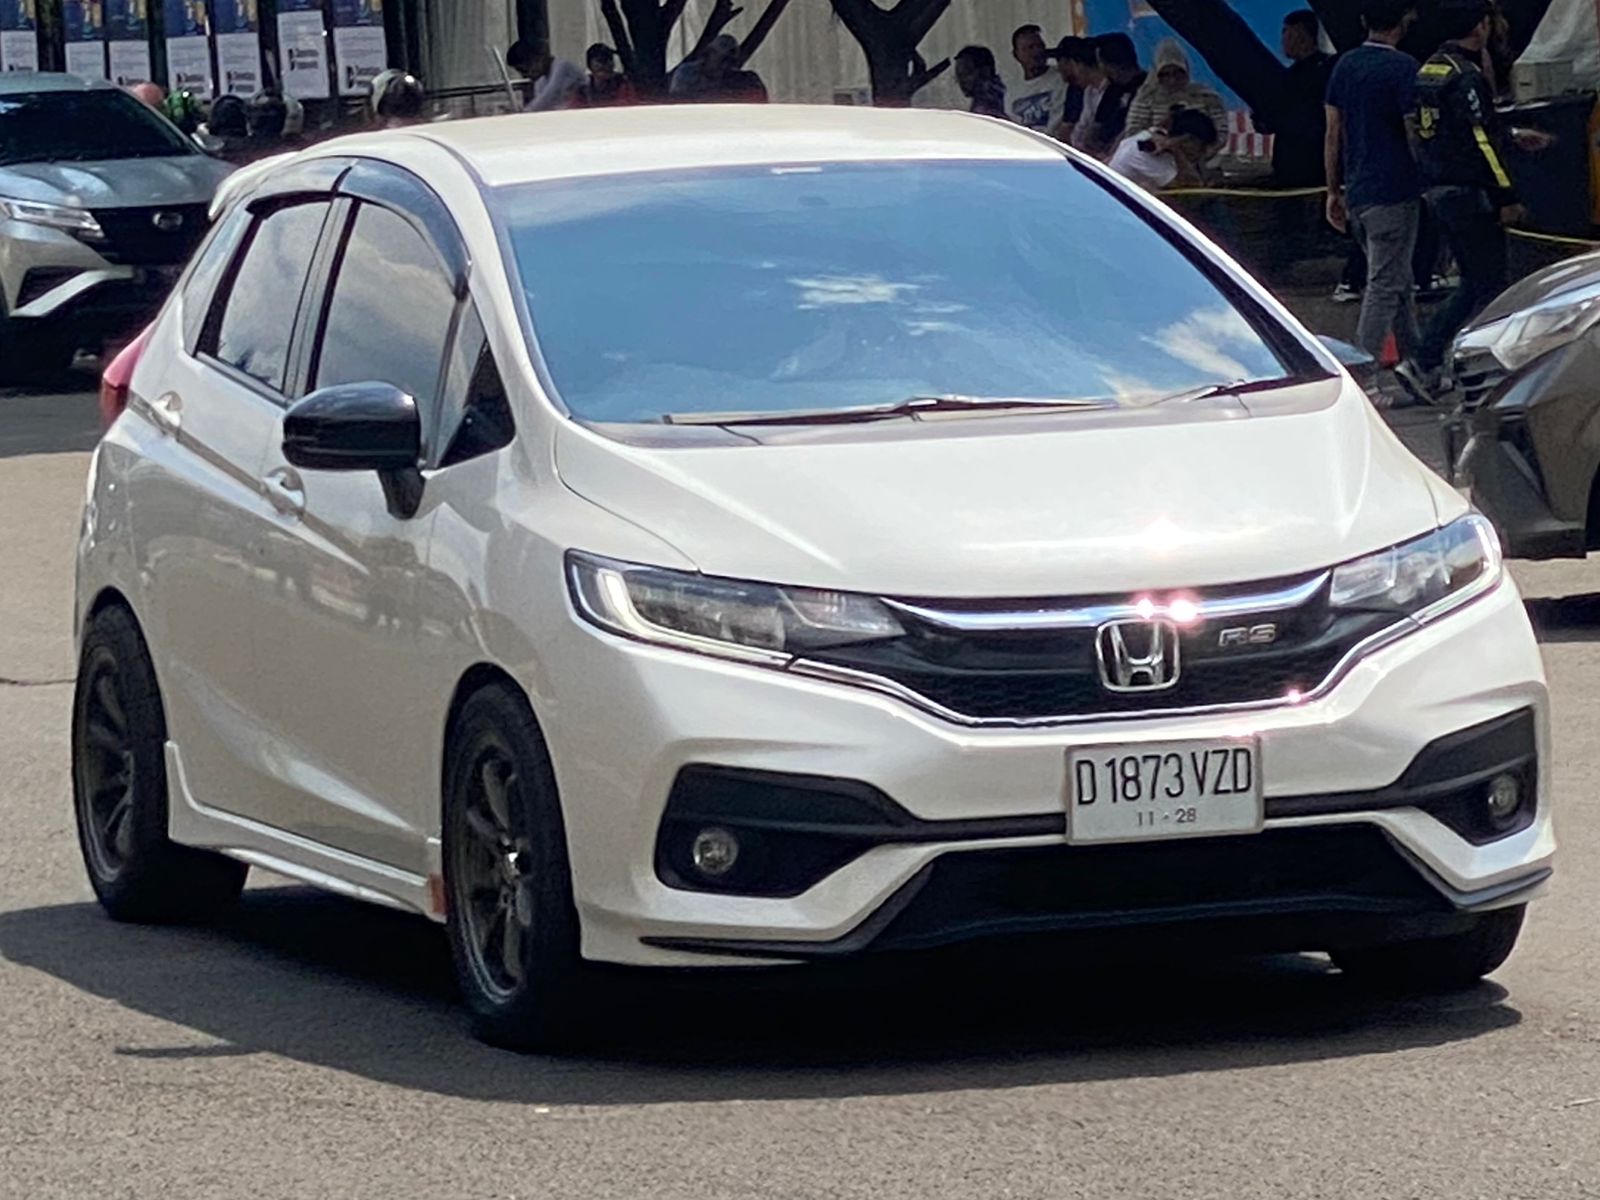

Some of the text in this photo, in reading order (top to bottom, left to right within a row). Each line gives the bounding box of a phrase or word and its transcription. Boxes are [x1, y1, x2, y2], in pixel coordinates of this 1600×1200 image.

[1219, 623, 1276, 647] RS
[1076, 748, 1252, 805] D 1873 VZD
[1175, 808, 1197, 824] 28
